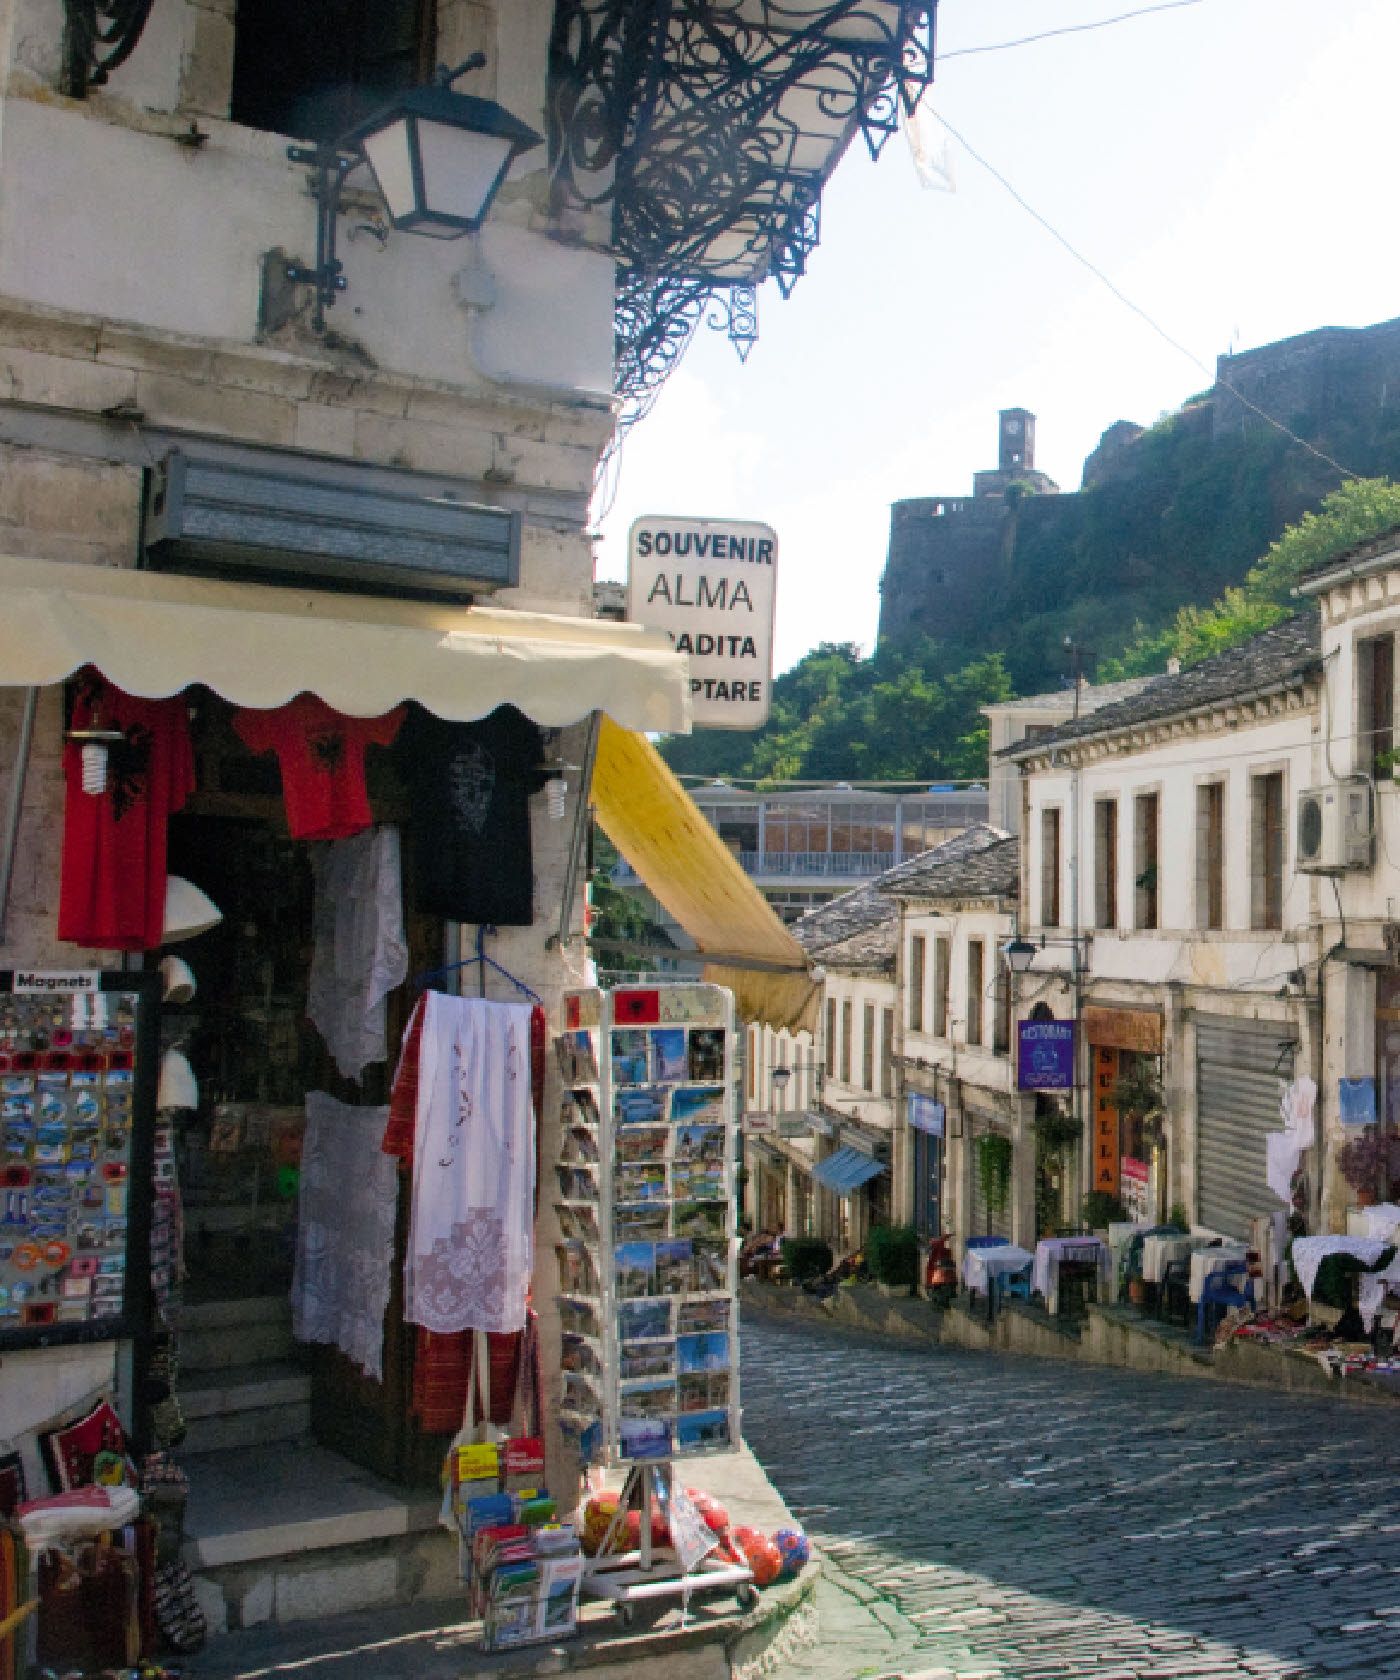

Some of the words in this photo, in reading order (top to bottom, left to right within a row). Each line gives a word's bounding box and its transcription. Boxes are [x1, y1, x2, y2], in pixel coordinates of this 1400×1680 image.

[637, 530, 773, 564] SOUVENIR
[648, 573, 753, 612] ALMA
[668, 631, 757, 658] ADITA
[18, 973, 91, 990] Magnets
